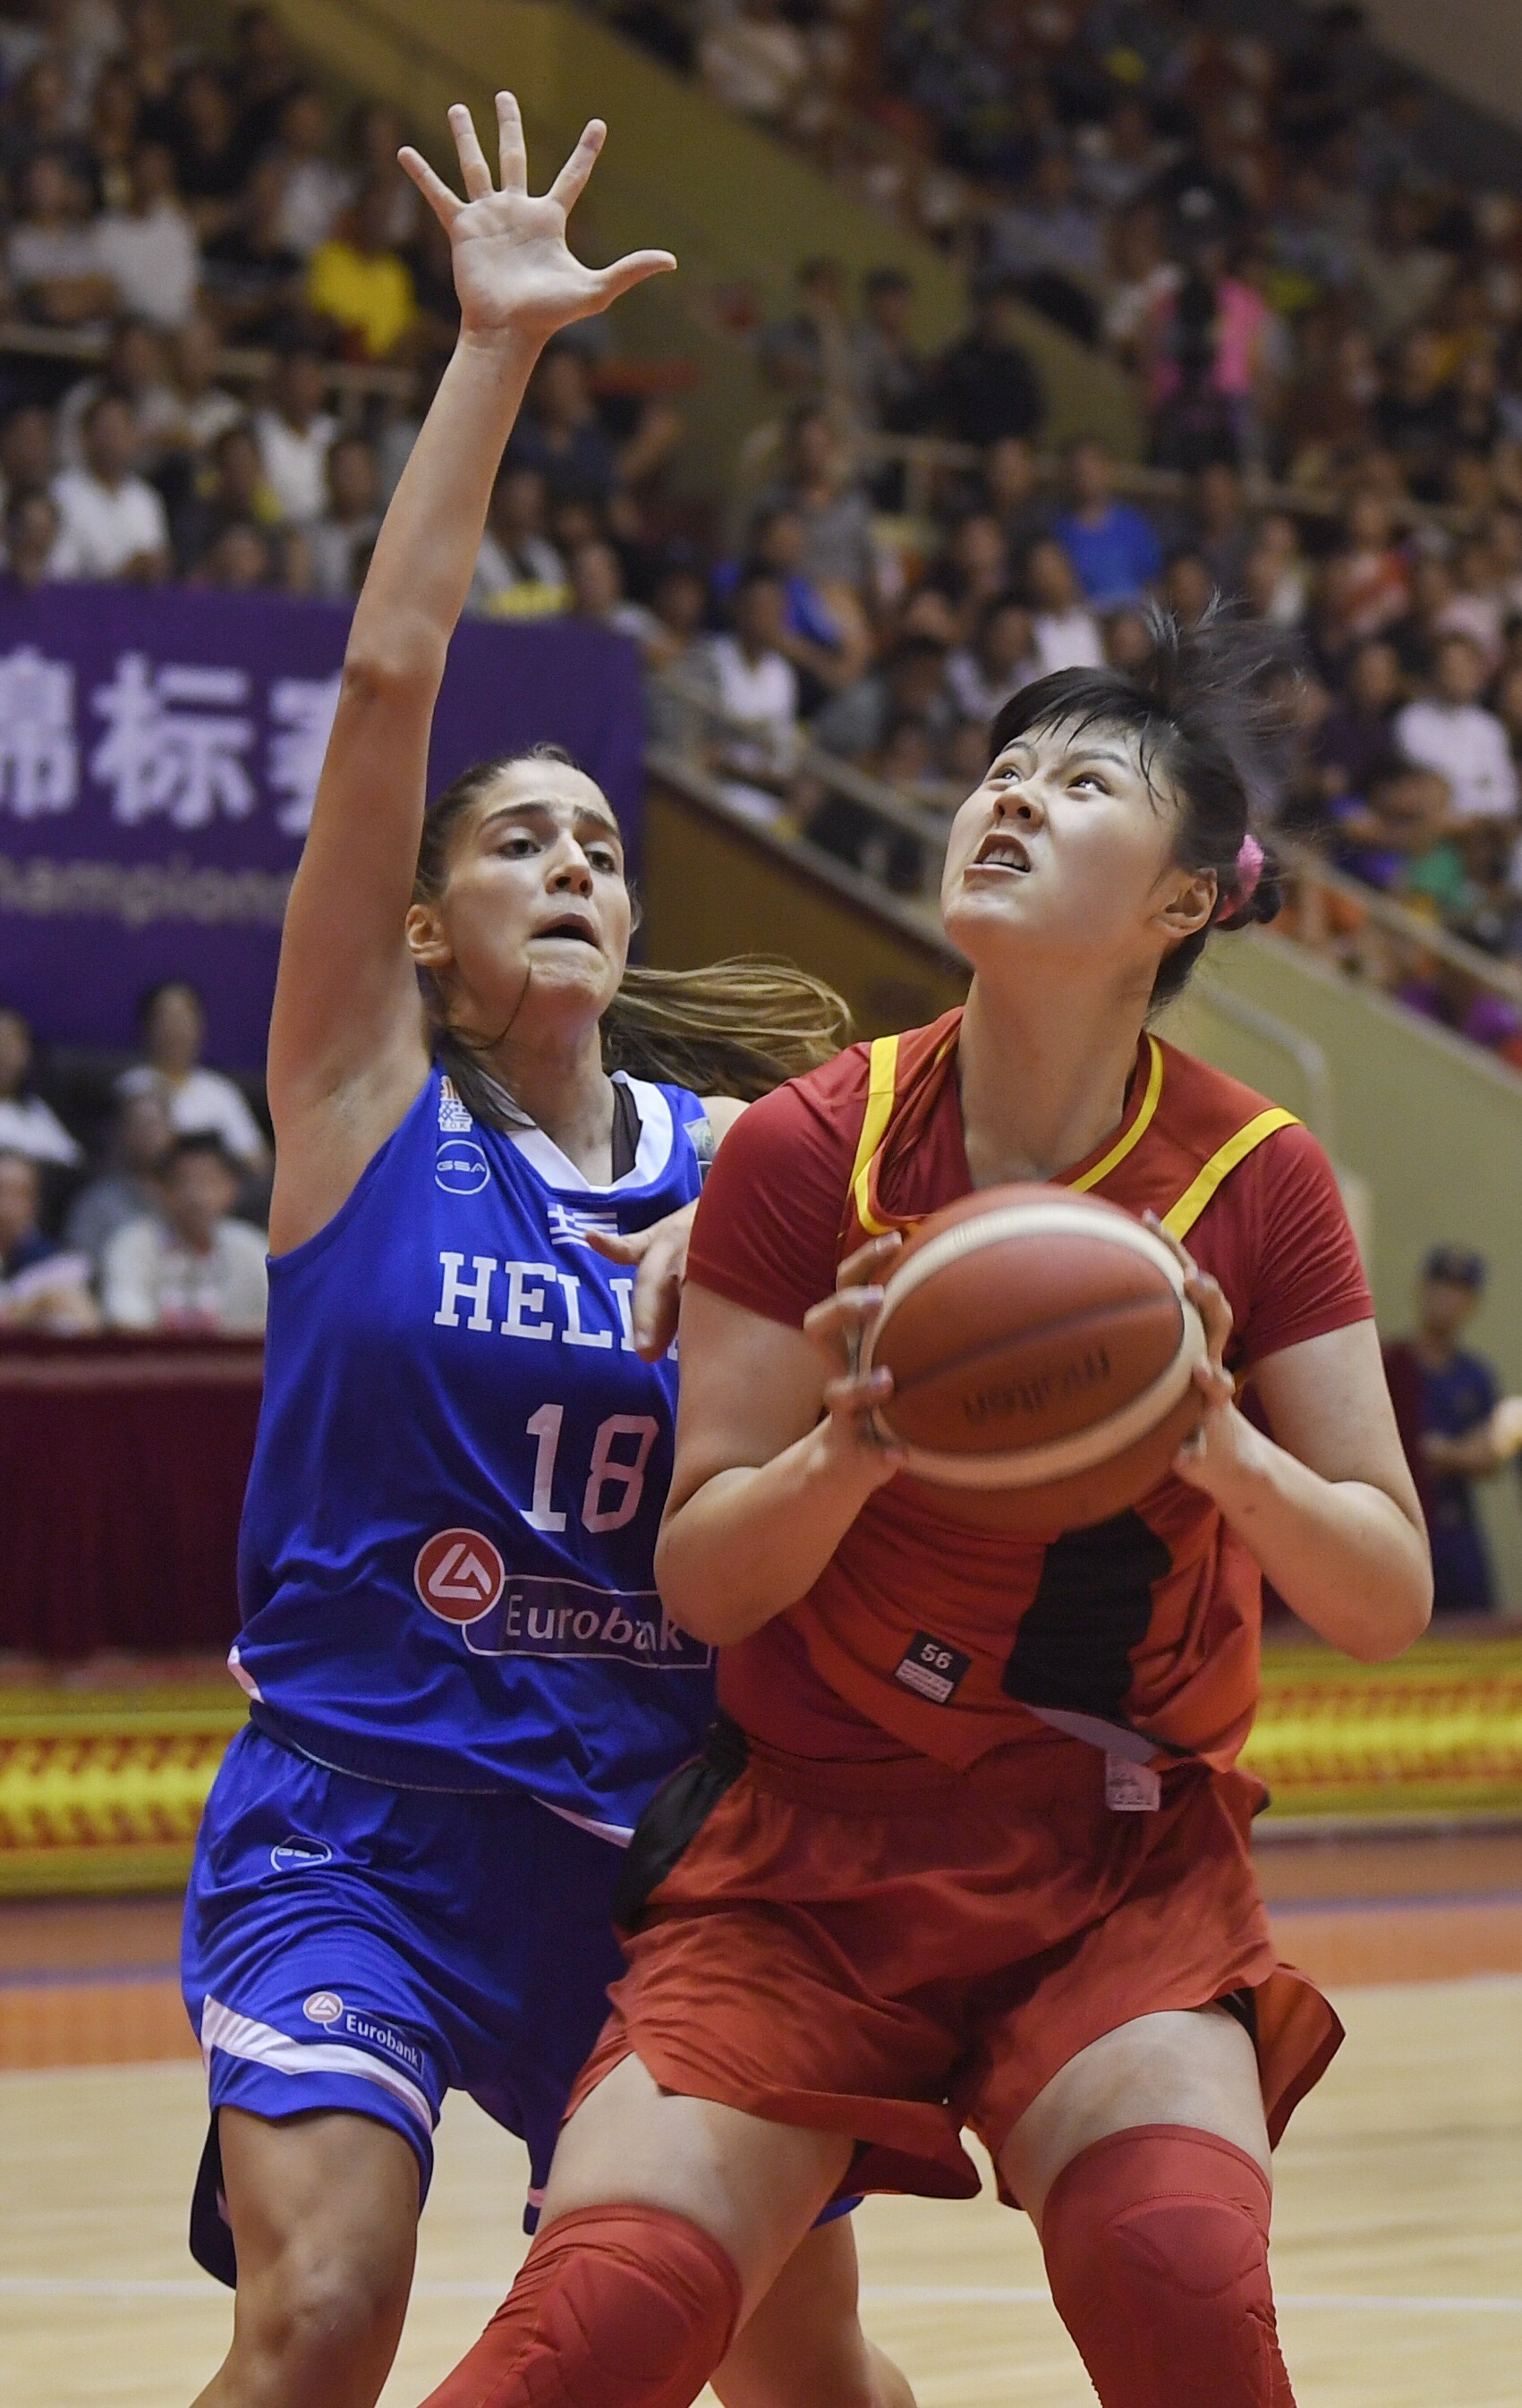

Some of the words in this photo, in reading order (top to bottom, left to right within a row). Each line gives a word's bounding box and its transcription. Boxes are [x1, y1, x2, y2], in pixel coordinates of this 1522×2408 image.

[434, 1251, 678, 1361] HELL
[519, 1403, 659, 1533] 18
[920, 1643, 953, 1669] 56
[345, 2014, 419, 2065] Eurobank
